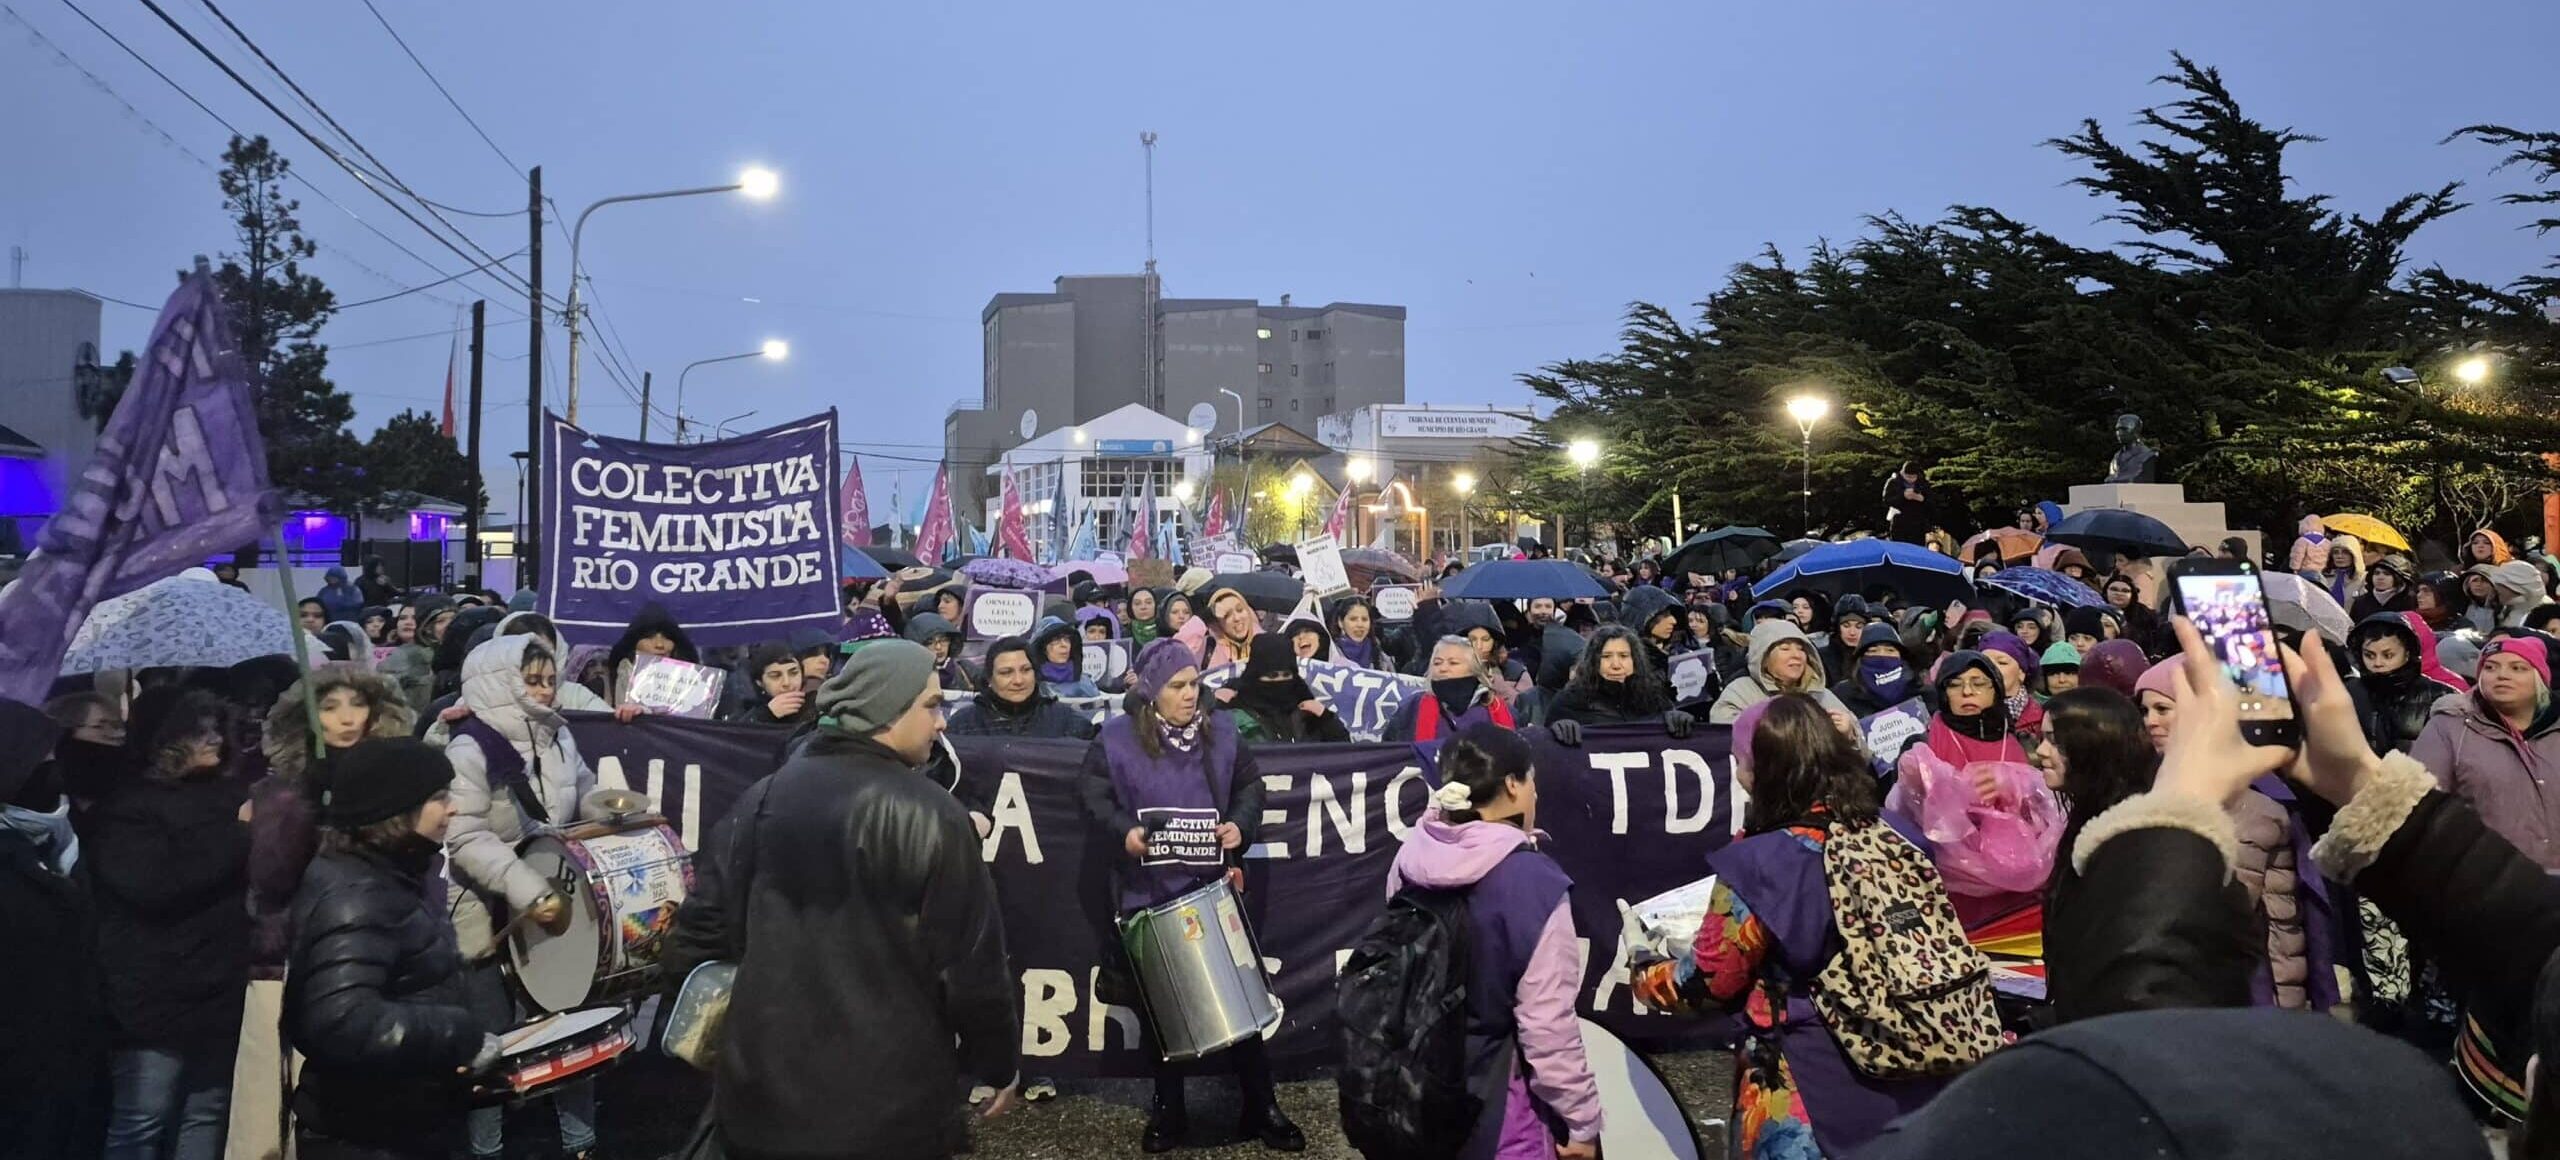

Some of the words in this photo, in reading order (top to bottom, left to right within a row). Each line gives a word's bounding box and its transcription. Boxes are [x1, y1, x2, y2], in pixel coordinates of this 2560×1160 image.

[1408, 415, 1434, 423] TRIBUNAL
[1443, 416, 1467, 424] CUENTAS
[1468, 416, 1497, 425] MUNICIPAL
[1465, 426, 1488, 434] GRANDE
[571, 453, 820, 504] COLECTIVA
[572, 500, 821, 552] FEMINISTA
[571, 550, 639, 591] RÍO
[650, 550, 822, 593] GRANDE
[1250, 766, 1441, 858] ENO
[1171, 845, 1217, 857] GRANDE
